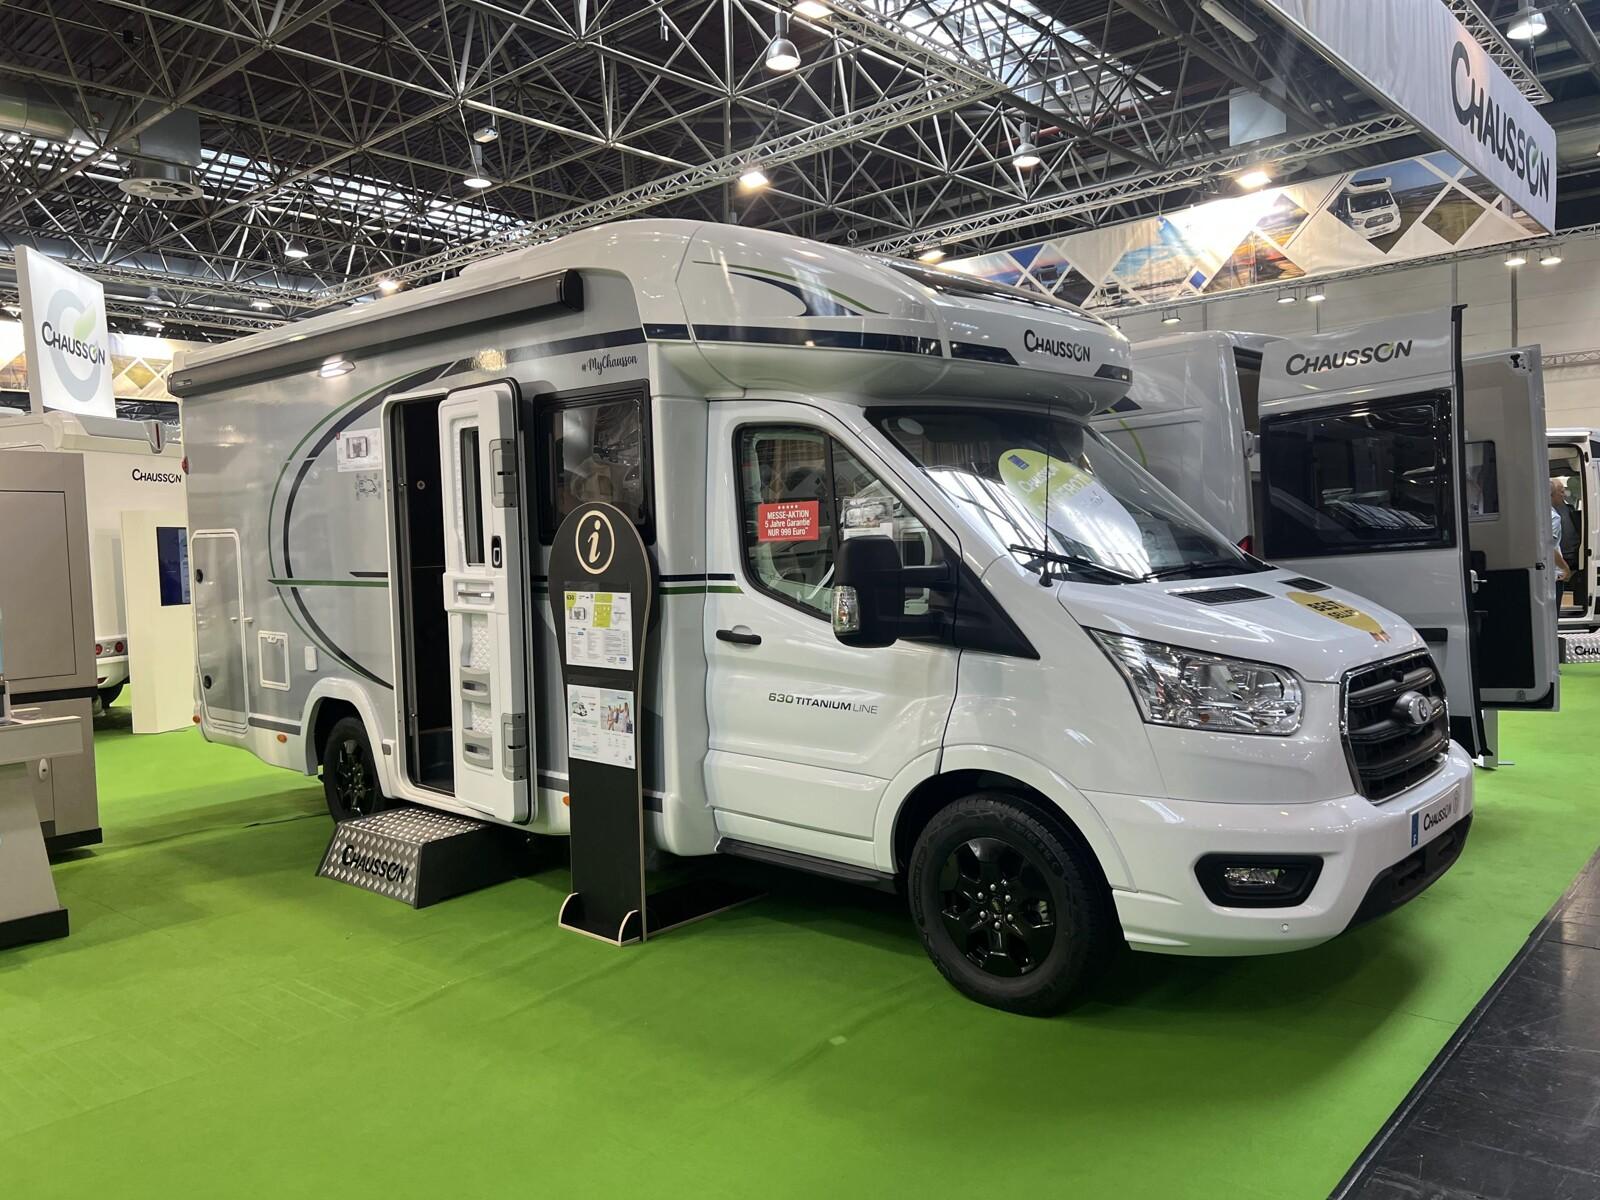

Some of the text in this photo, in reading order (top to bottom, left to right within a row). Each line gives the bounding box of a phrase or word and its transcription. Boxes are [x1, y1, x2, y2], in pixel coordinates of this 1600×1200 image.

[1451, 41, 1550, 203] CHAUSSON
[41, 321, 106, 366] CHAUSSON
[1023, 329, 1091, 362] CHAUSSON
[1285, 339, 1413, 376] CHAUSSON
[131, 468, 182, 484] CHAUSSON
[764, 520, 769, 529] 5
[770, 519, 786, 528] Jahre
[767, 510, 810, 520] MESSE-AKTION
[767, 529, 780, 537] NUR
[780, 528, 792, 536] 999
[768, 692, 795, 704] 630
[341, 844, 409, 884] CHAUSSON
